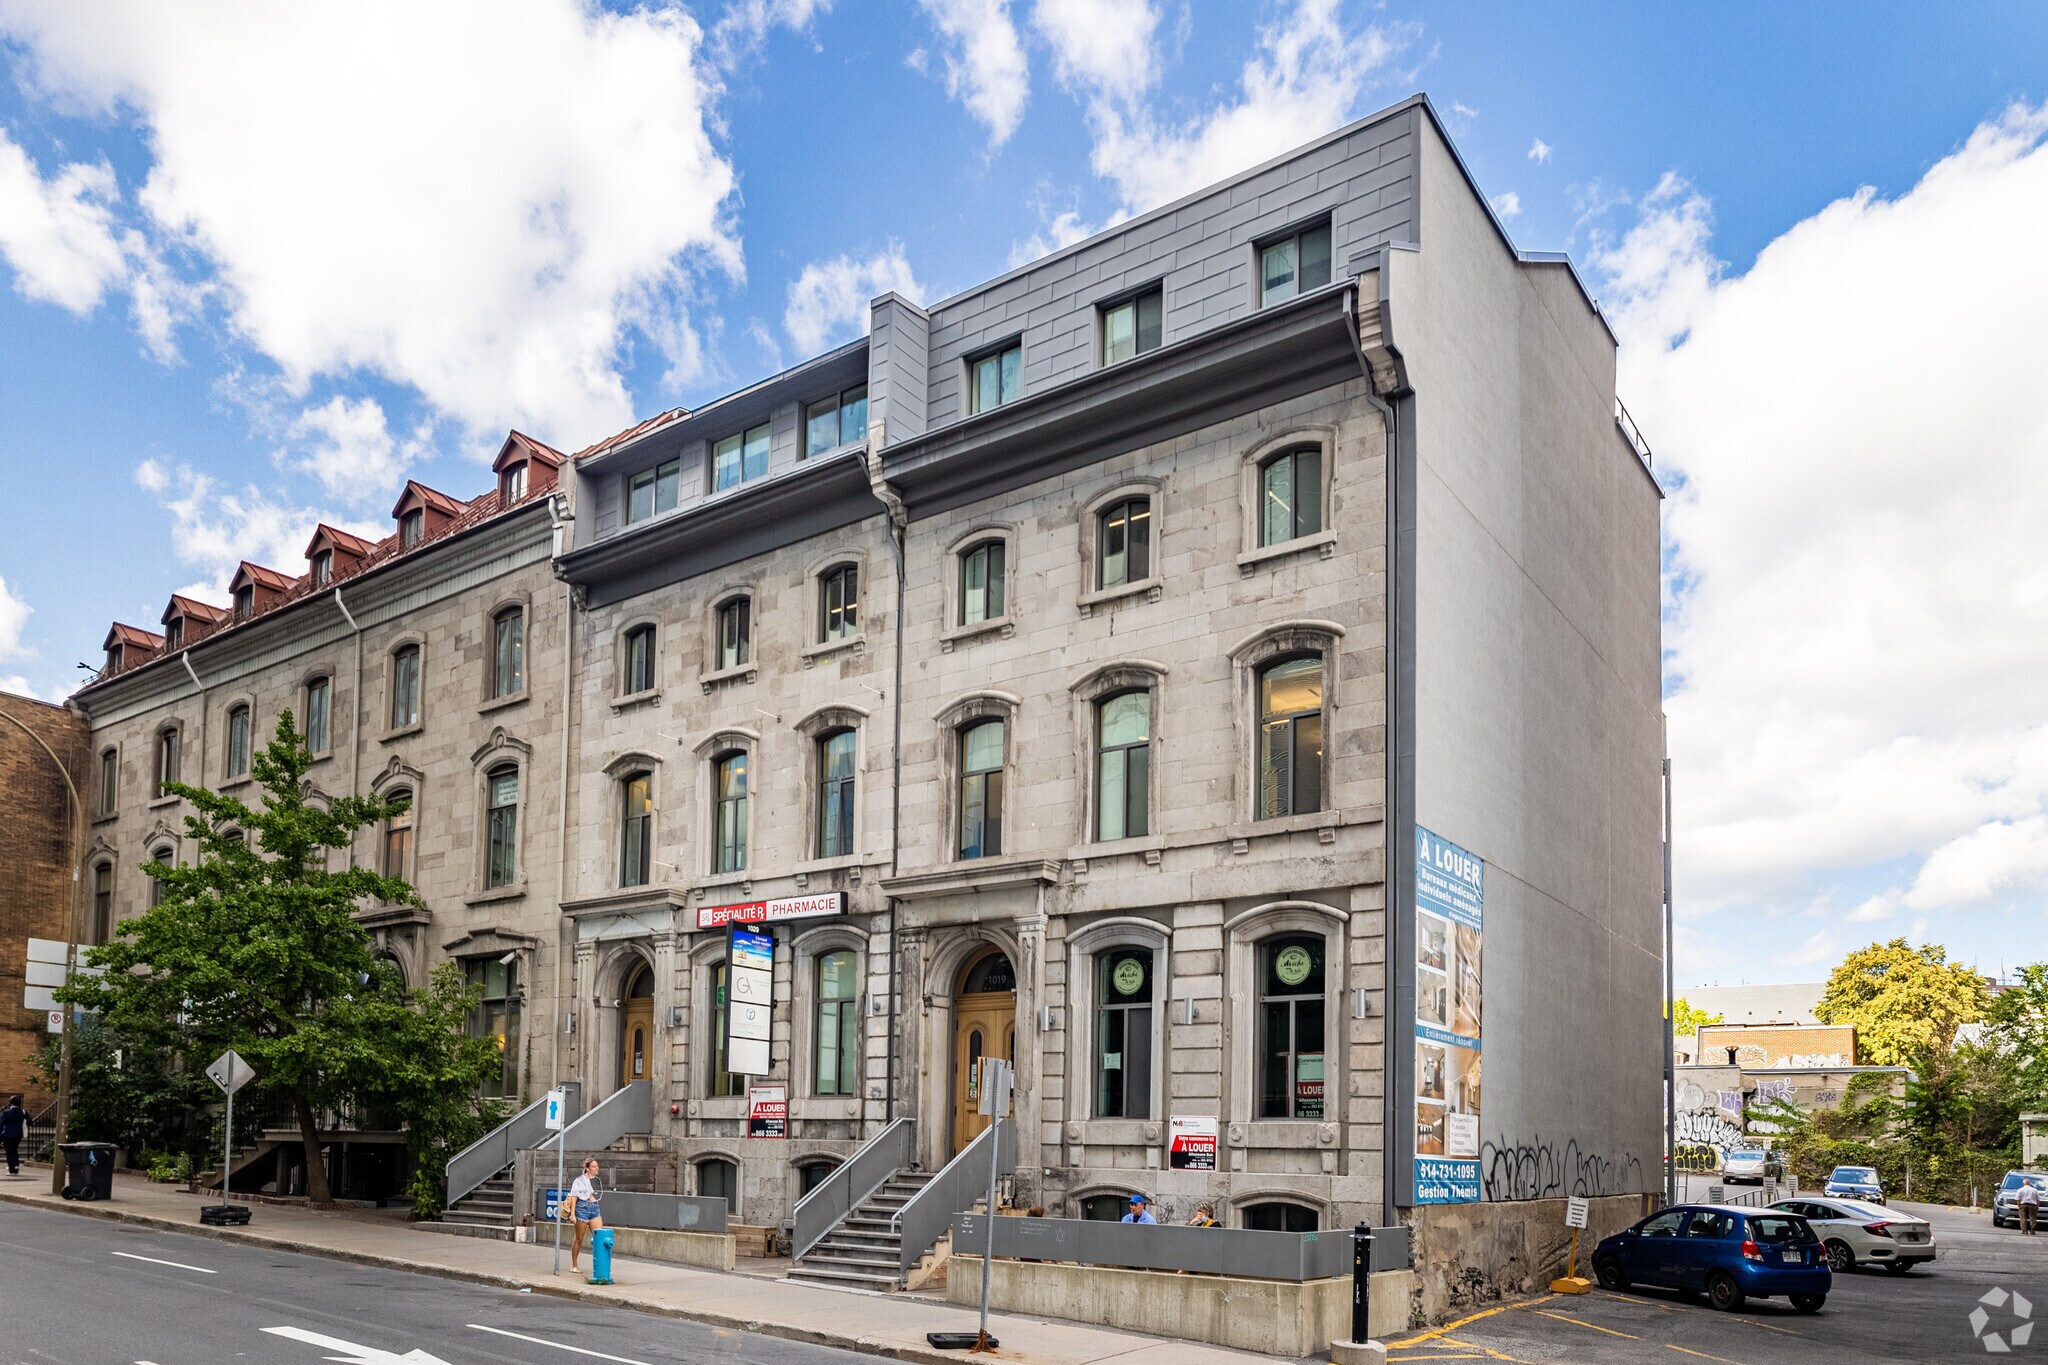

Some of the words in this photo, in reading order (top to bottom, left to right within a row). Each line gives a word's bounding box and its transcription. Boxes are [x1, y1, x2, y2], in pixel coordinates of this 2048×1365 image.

[1420, 832, 1430, 863] À
[1435, 844, 1480, 887] LOUER
[1422, 867, 1448, 889] Bureaux
[1449, 883, 1477, 902] médicaux
[713, 904, 756, 922] SPÉCIALITÉ
[772, 898, 836, 915] PHARMACIE
[1453, 897, 1481, 917] aménagés
[989, 975, 1007, 985] 1019
[1425, 1028, 1455, 1043] Entièrement
[756, 1102, 762, 1112] À
[763, 1104, 785, 1112] LOUER
[1181, 1140, 1187, 1152] À
[1189, 1143, 1214, 1152] LOUER
[1421, 1163, 1475, 1178] 514-731-1095
[1418, 1184, 1448, 1198] Gestion
[1451, 1184, 1478, 1198] Thémis
